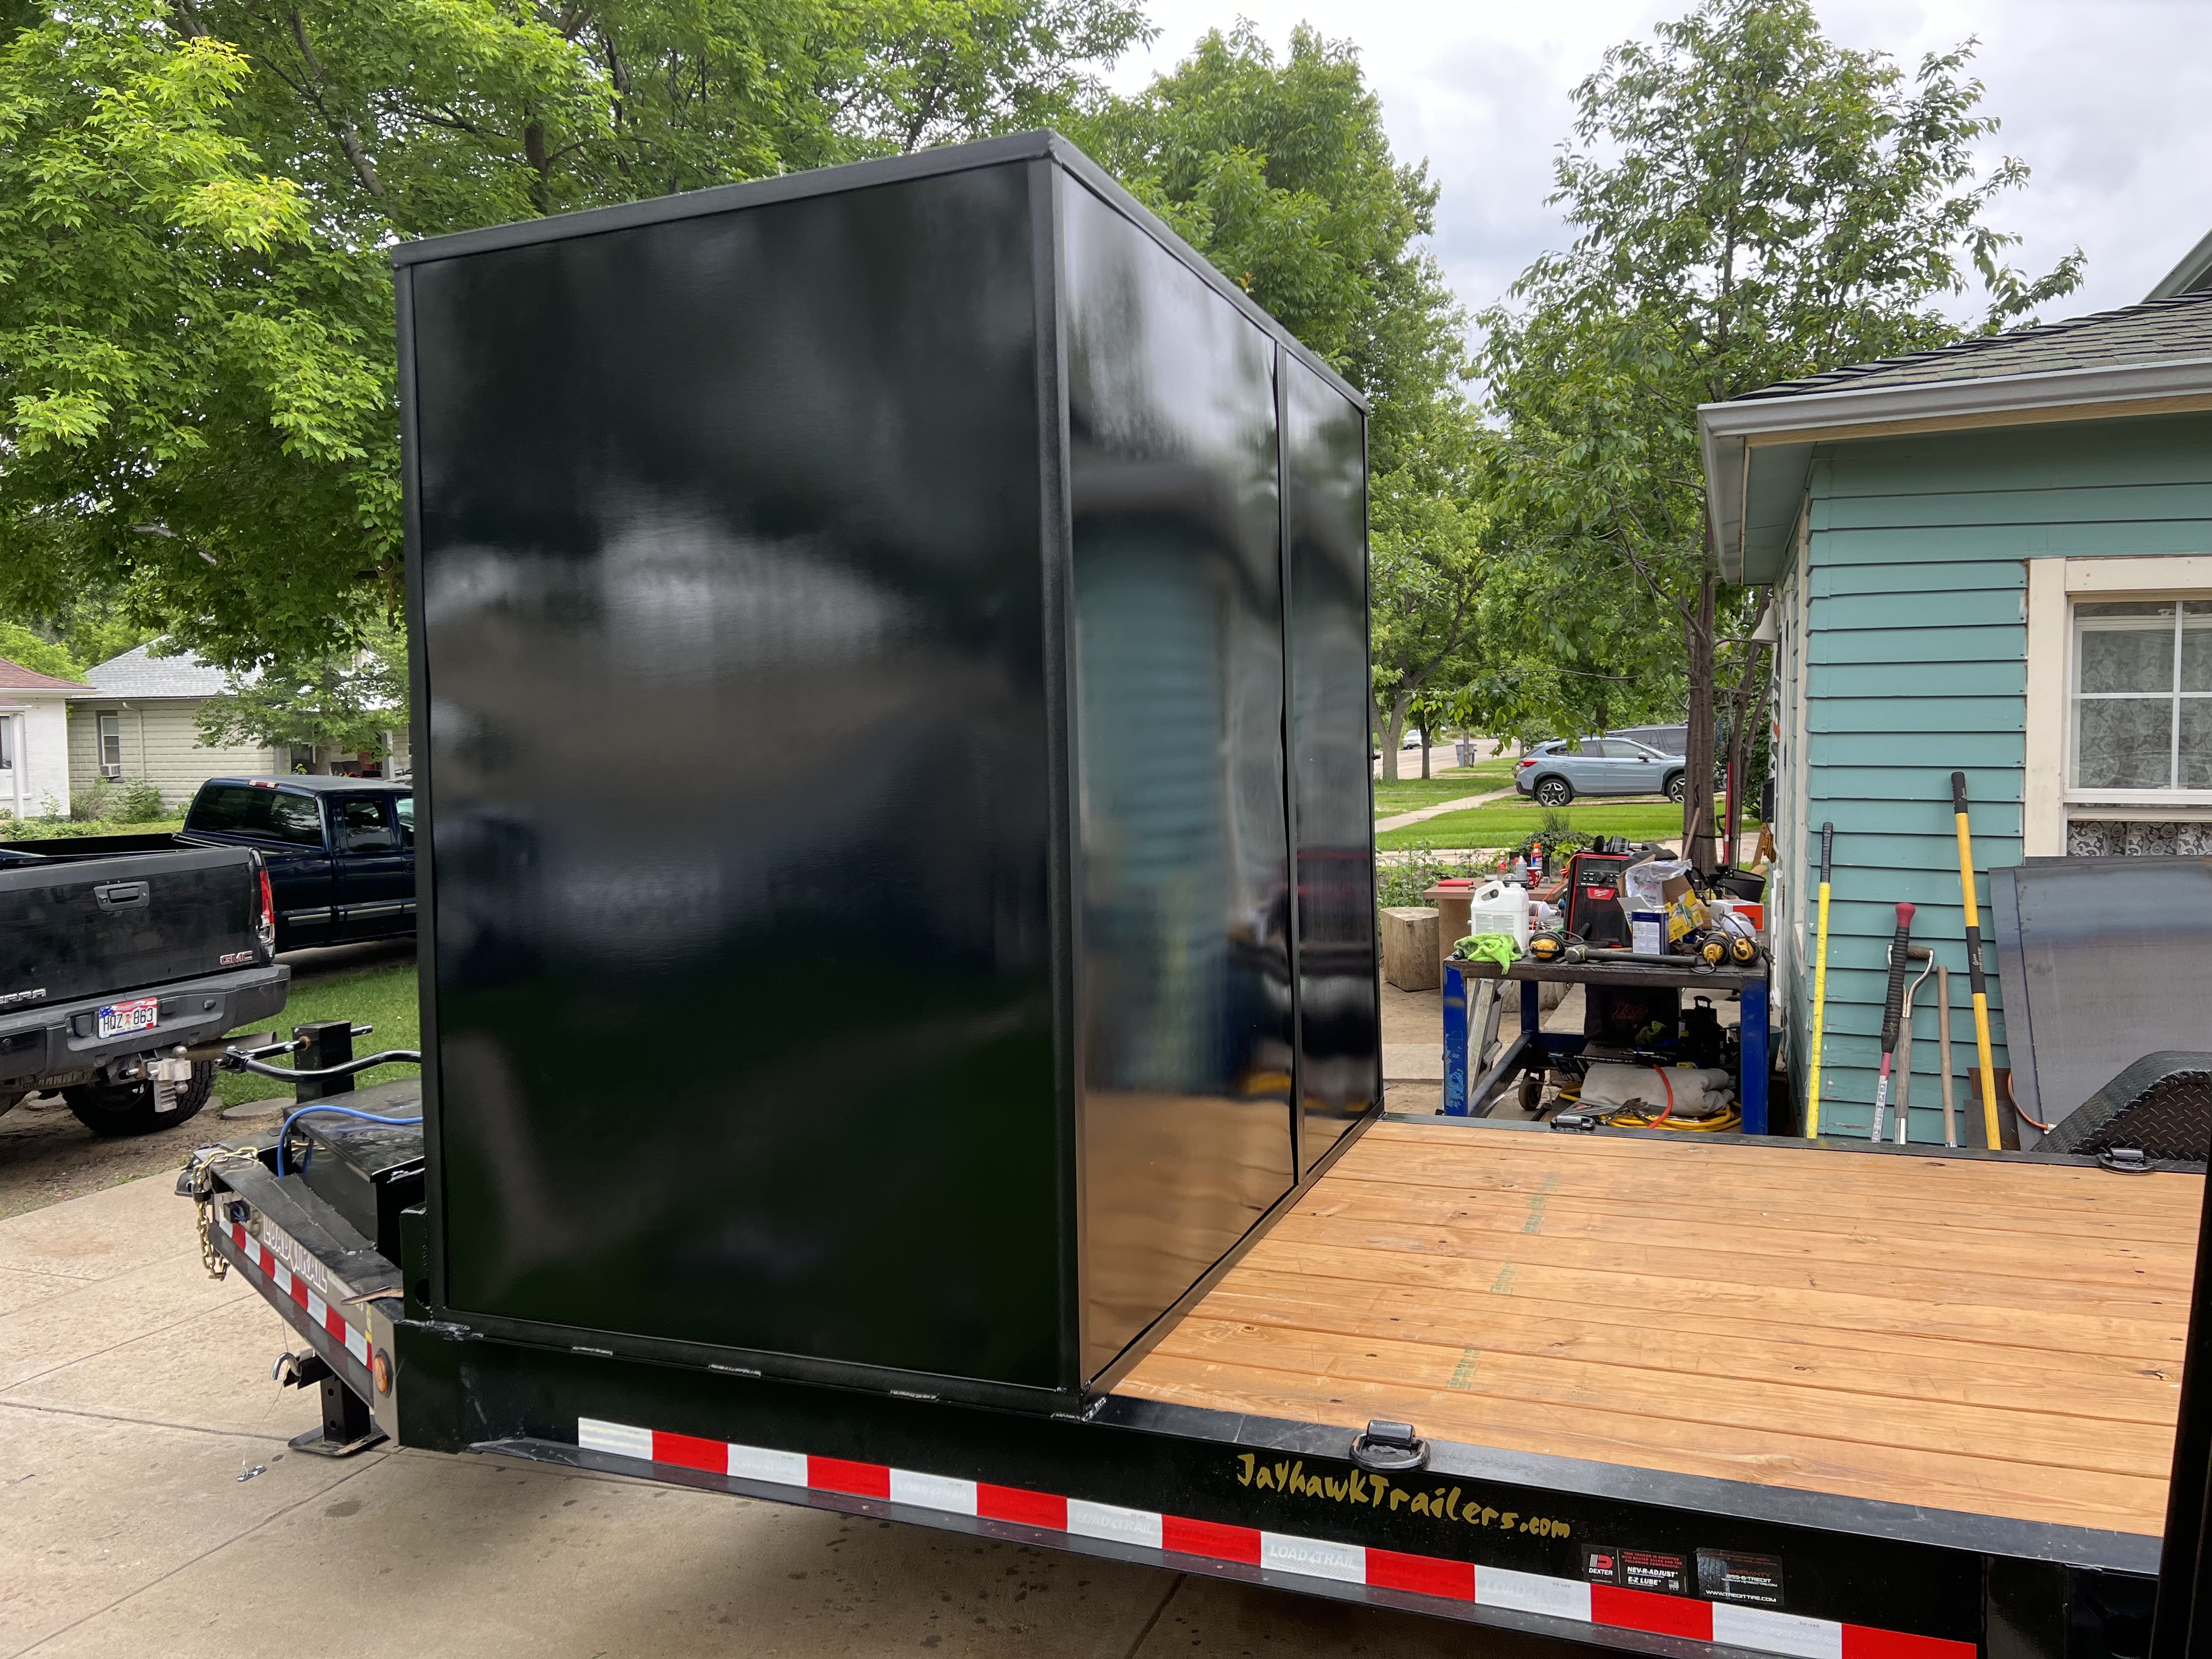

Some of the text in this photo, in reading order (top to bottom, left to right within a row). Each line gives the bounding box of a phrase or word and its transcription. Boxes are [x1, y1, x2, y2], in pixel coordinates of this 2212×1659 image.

[220, 950, 253, 965] GMC
[104, 1008, 153, 1031] HQZ 863
[1237, 1454, 1570, 1538] JayhawkTrailers.com
[1270, 1544, 1356, 1569] LOAD TRAIL
[1588, 1567, 1613, 1576] DEXTER
[1727, 1568, 1771, 1577] WARRANTY
